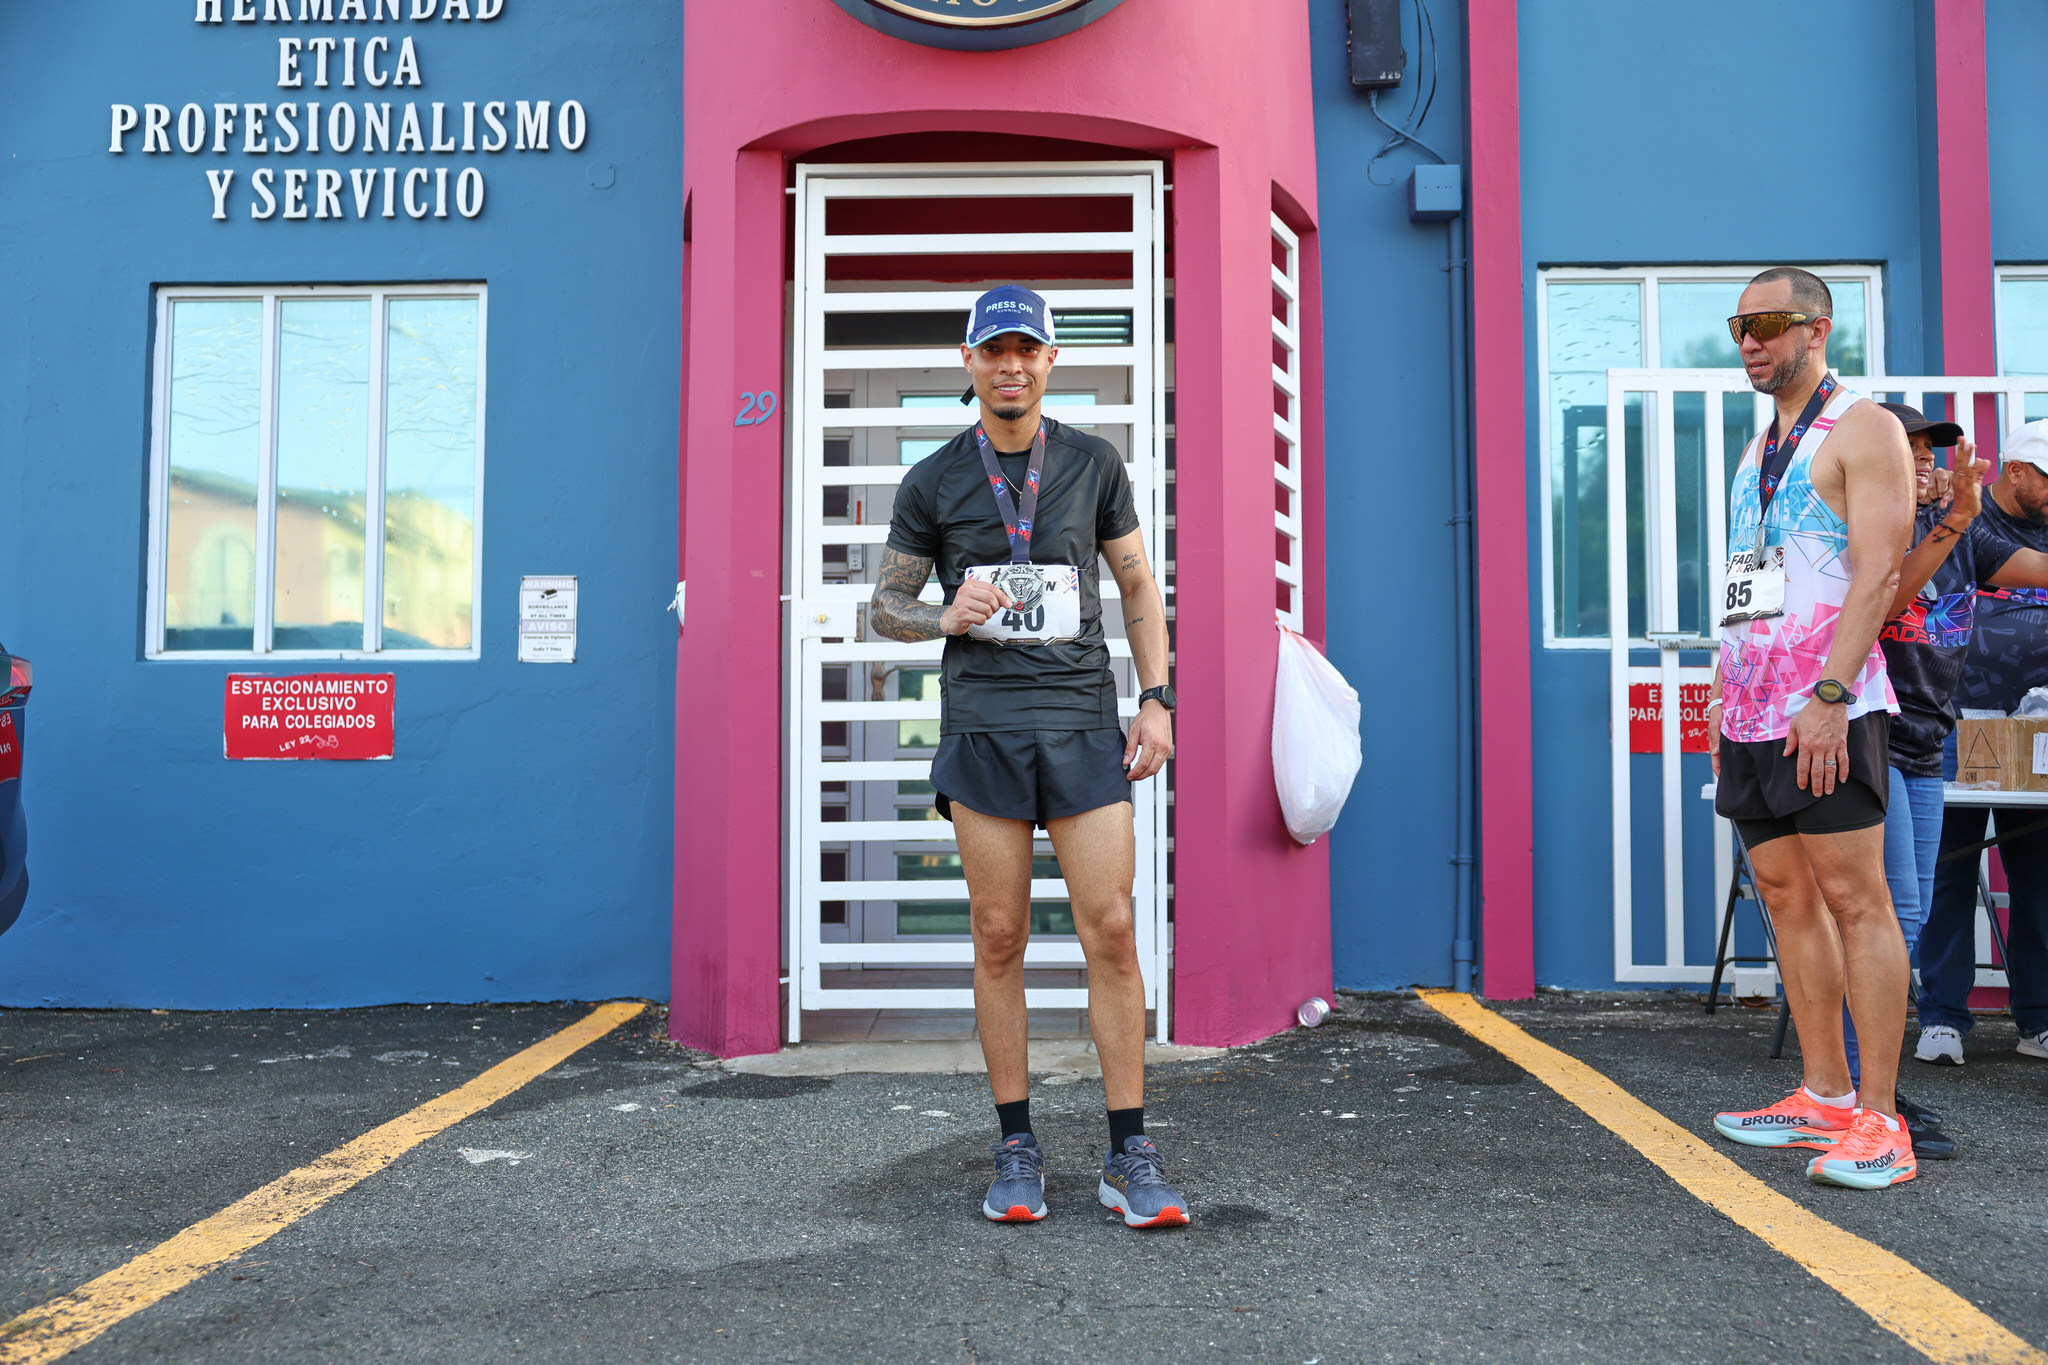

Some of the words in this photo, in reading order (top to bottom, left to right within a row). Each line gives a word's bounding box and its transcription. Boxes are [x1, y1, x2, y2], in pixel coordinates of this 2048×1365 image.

[277, 36, 422, 87] ETICA
[108, 100, 586, 153] PROFESIONALISMO
[206, 169, 234, 219] Y
[251, 167, 485, 219] SERVICIO
[986, 301, 1016, 314] PRESS
[1018, 303, 1033, 314] ON
[735, 391, 777, 427] 29
[1730, 553, 1755, 566] FAD
[1726, 580, 1752, 610] 85
[528, 621, 568, 632] AVISO
[1002, 604, 1045, 632] 40
[1943, 630, 1972, 647] RU
[231, 680, 388, 695] ESTACIONAMIENTO
[262, 696, 356, 711] EXCLUSIVO
[242, 715, 279, 729] PARA
[285, 714, 376, 729] COLEGIADOS
[279, 739, 296, 752] LEY
[299, 735, 310, 745] 22
[1741, 1114, 1808, 1126] BROOKS
[1855, 1148, 1896, 1169] BROOKS
